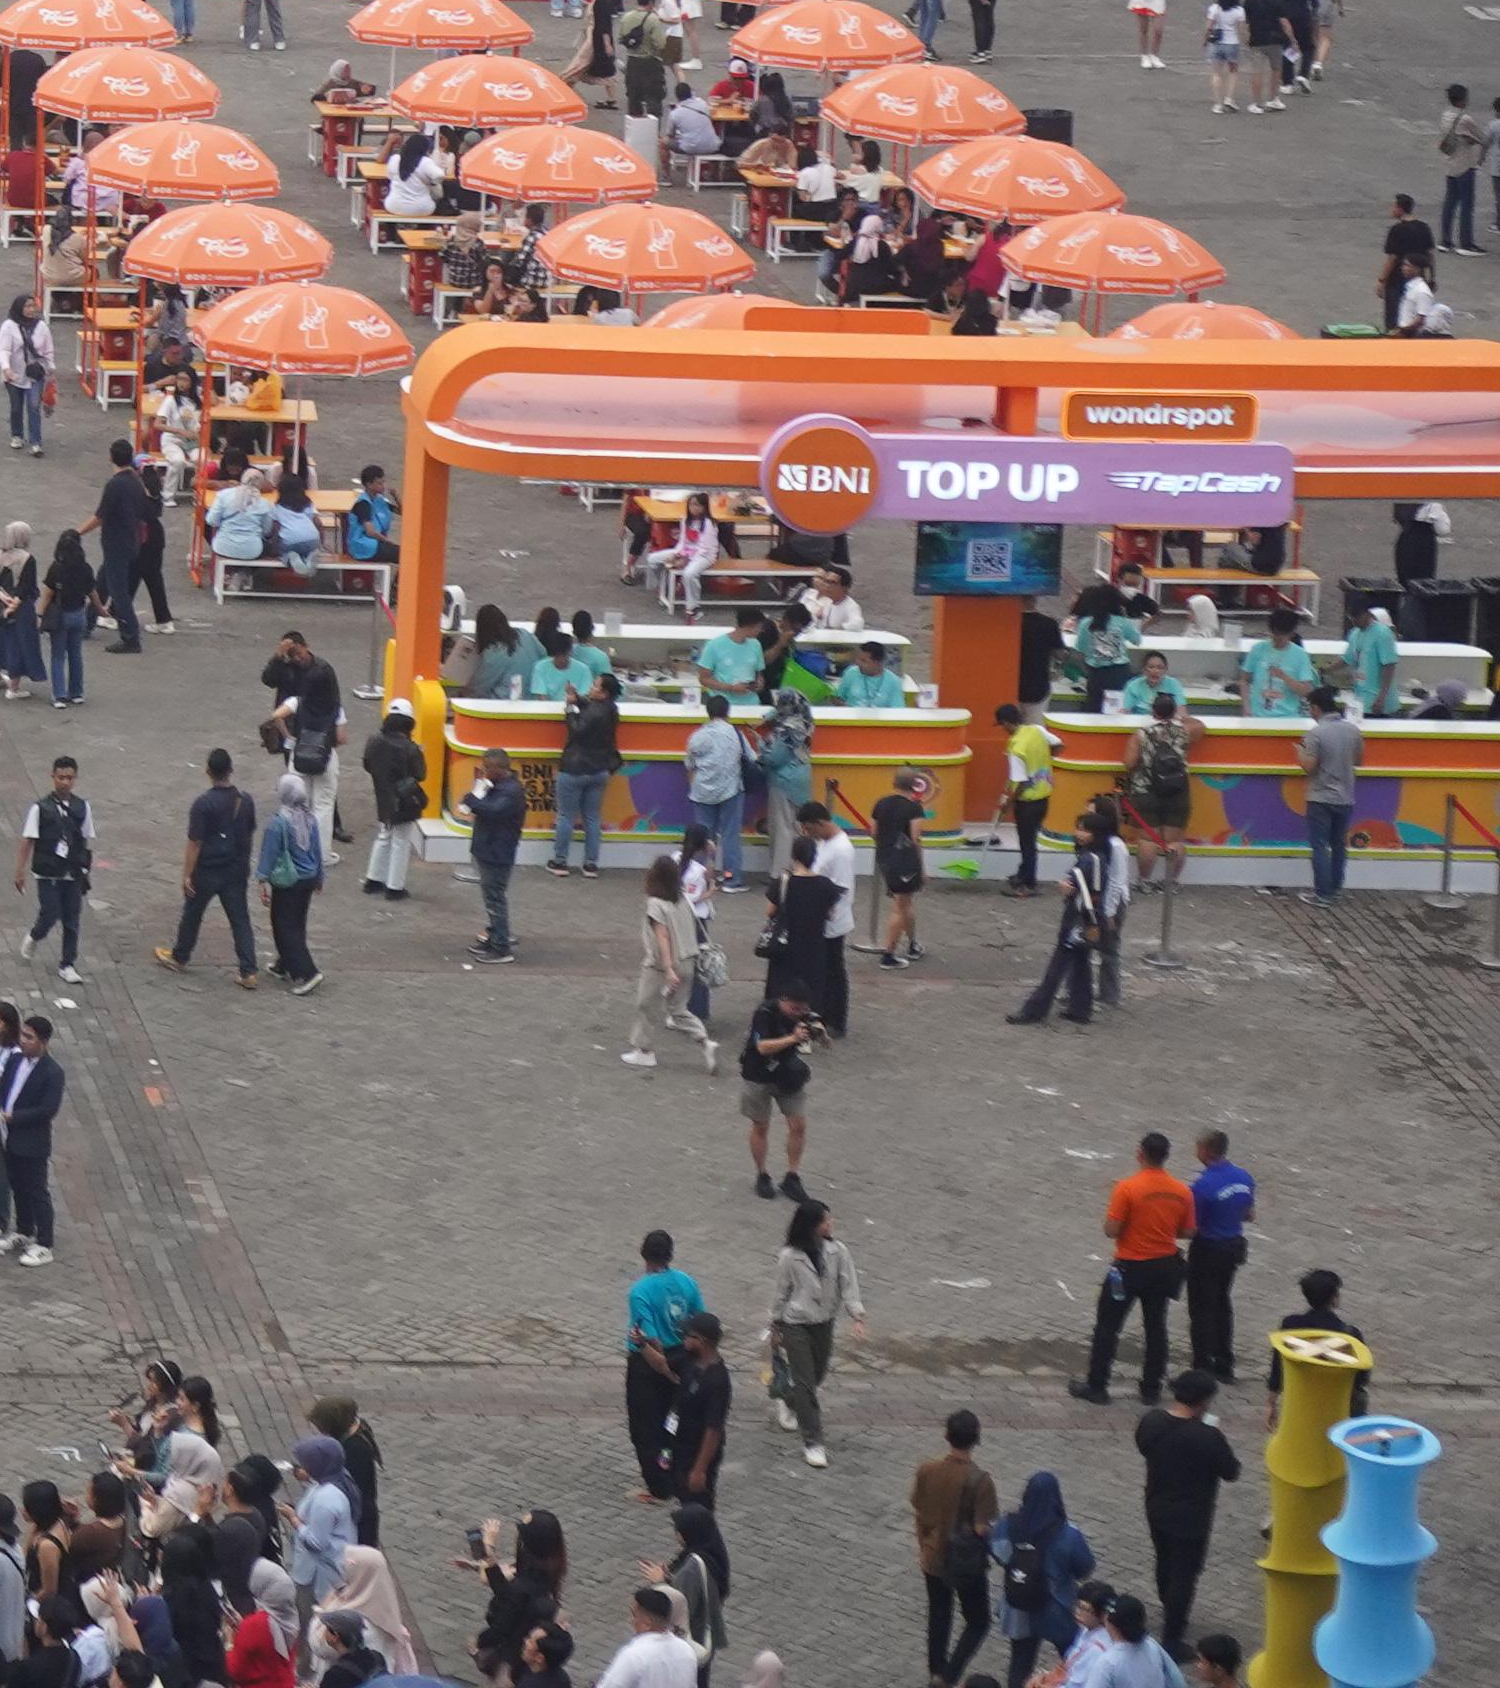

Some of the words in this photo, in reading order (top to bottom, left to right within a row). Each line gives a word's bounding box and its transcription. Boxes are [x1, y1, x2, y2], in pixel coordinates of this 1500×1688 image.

[1086, 404, 1235, 430] wondrspot
[805, 467, 870, 494] BNI
[899, 460, 1000, 501] TOP
[1008, 463, 1079, 503] UP
[1137, 469, 1283, 497] TapCash
